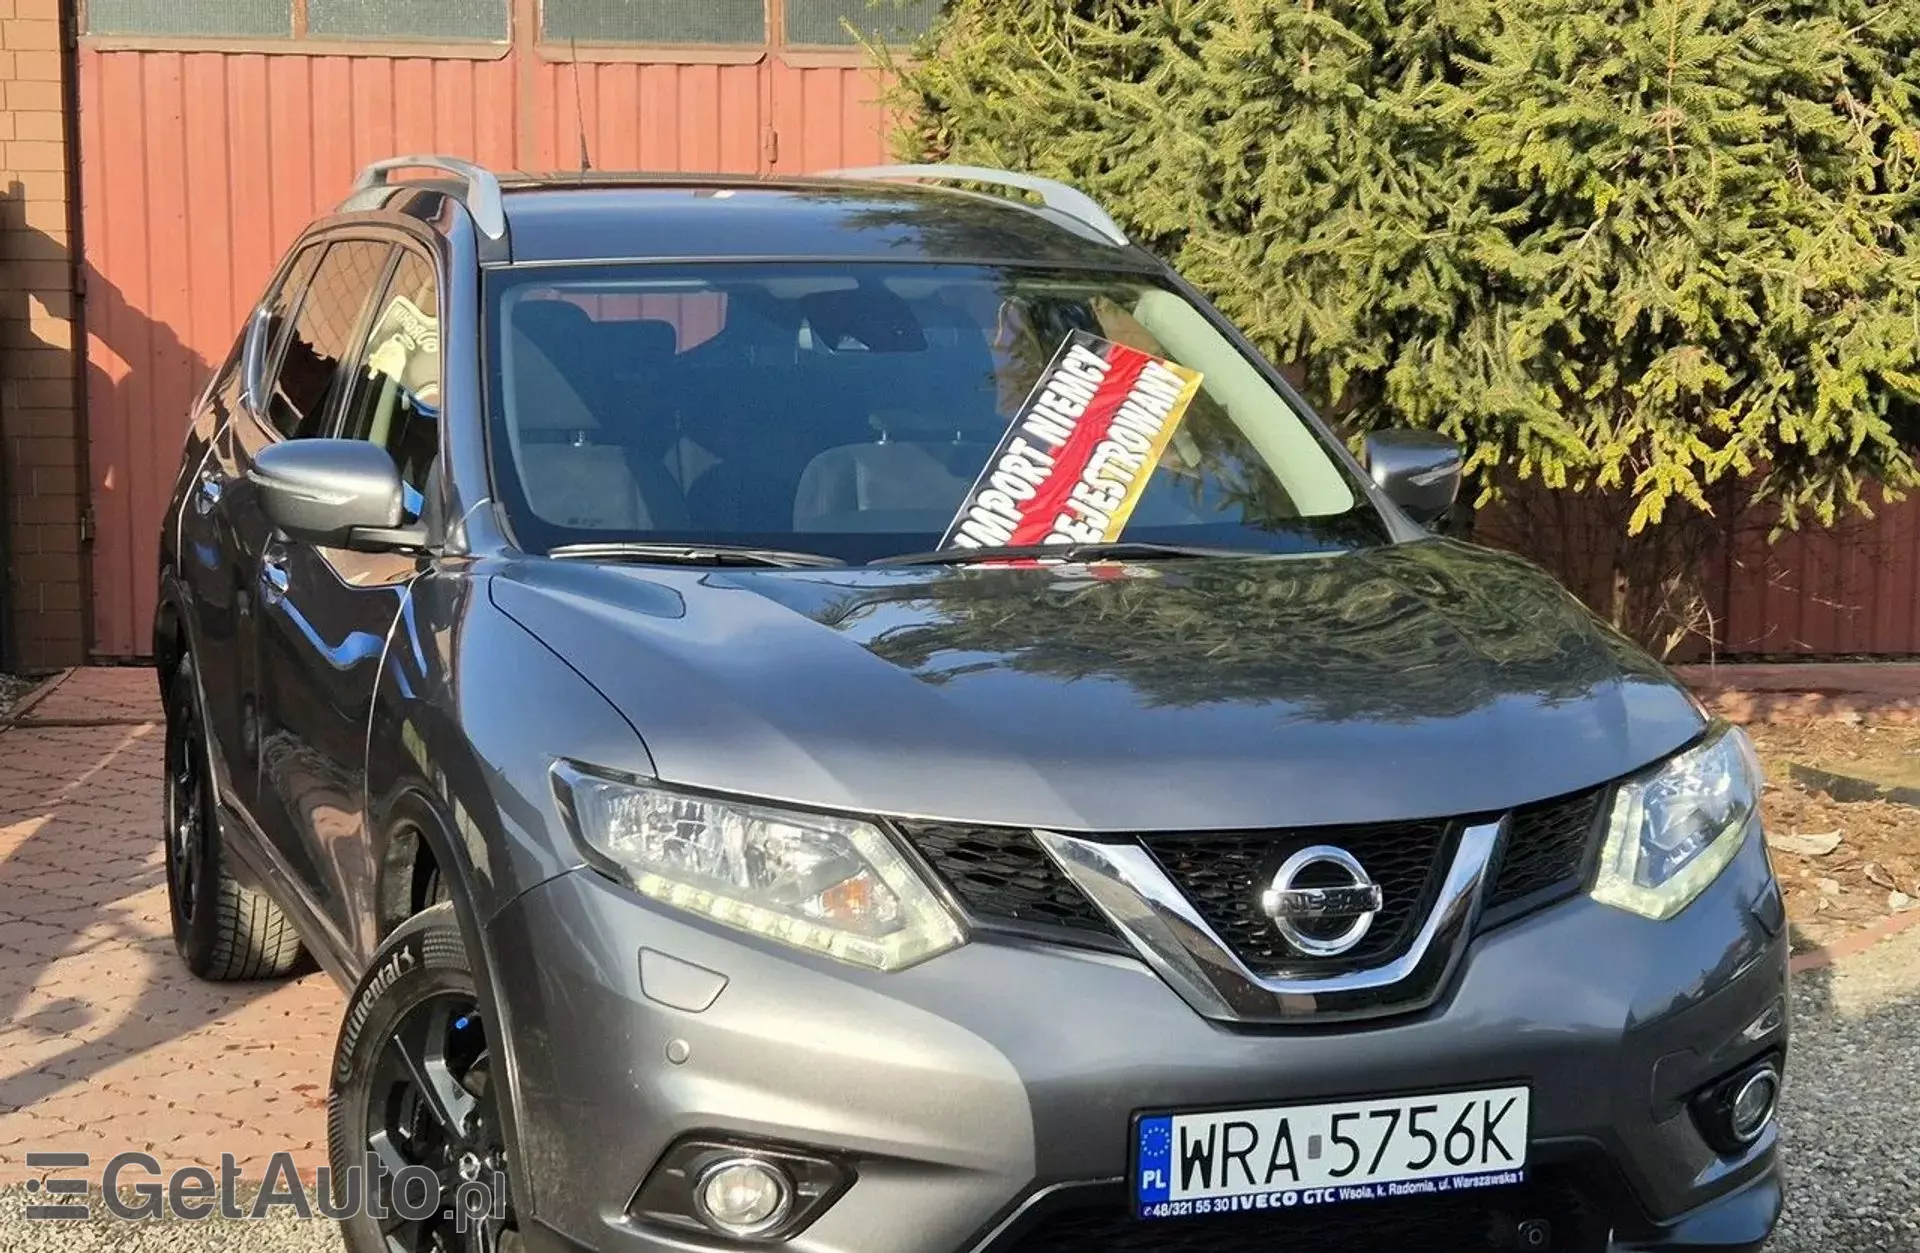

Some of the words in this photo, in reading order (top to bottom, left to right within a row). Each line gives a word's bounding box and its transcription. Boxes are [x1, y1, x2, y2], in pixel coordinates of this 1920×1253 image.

[1022, 344, 1112, 446] NIEMCY
[1180, 1117, 1300, 1191] WRA
[1328, 1096, 1518, 1178] 5756K
[1142, 1169, 1166, 1190] PL
[1153, 1202, 1192, 1217] 48/321
[1196, 1200, 1211, 1213] 55
[1214, 1198, 1229, 1212] 30
[1231, 1190, 1298, 1211] IVECO
[1453, 1172, 1517, 1189] Warszawska
